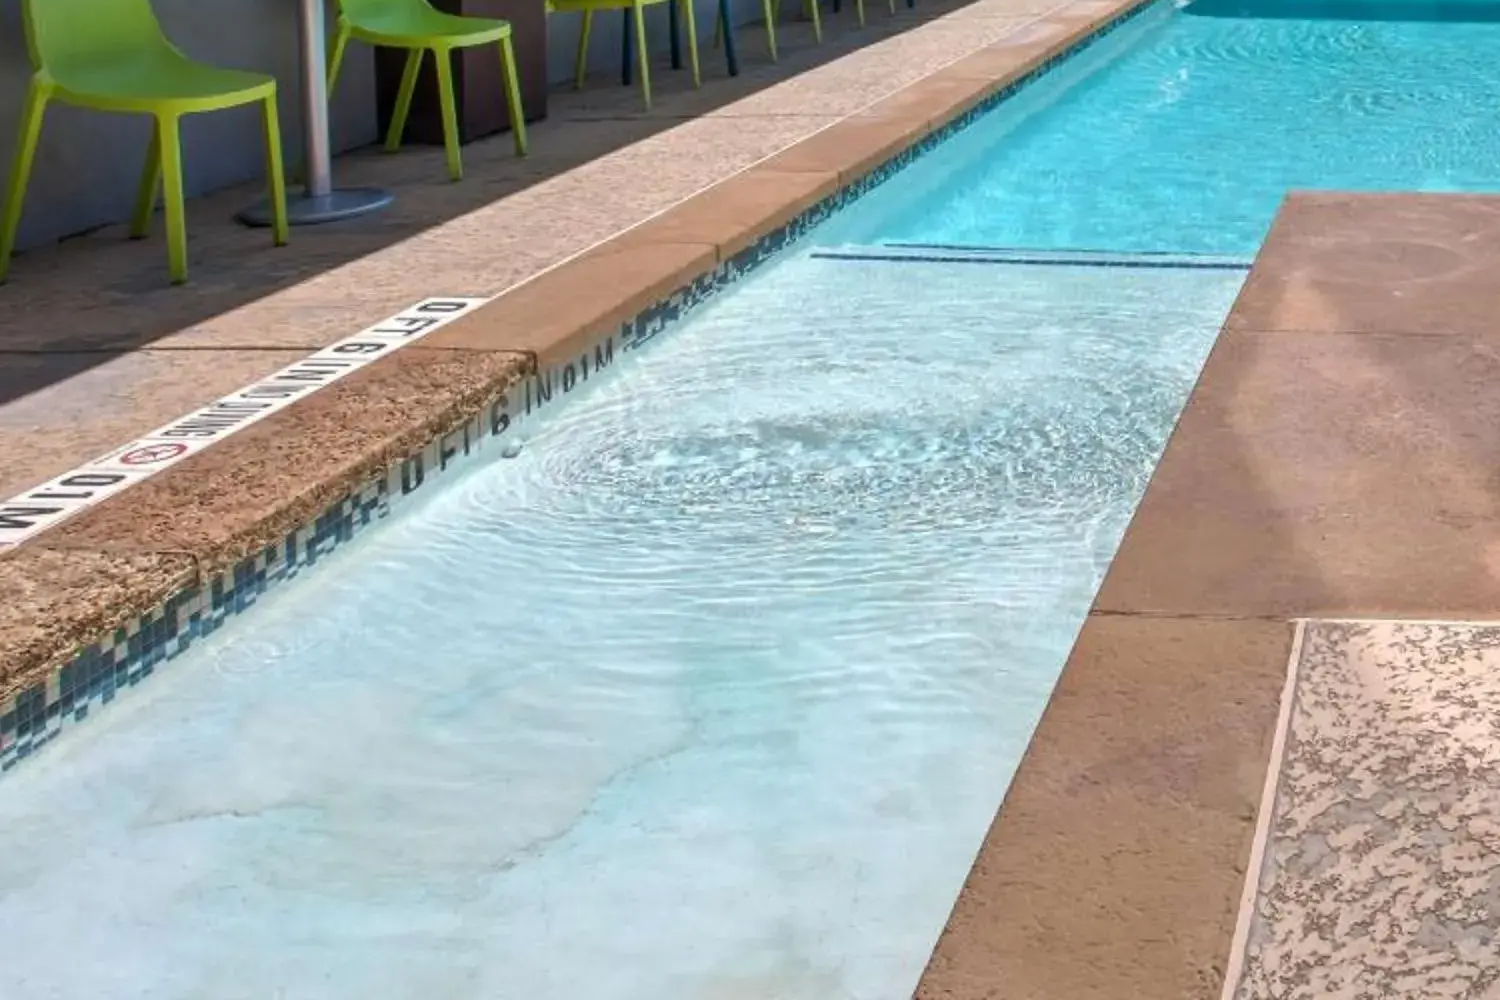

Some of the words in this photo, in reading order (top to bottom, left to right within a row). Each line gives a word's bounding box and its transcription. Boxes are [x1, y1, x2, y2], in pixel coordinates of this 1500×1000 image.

[370, 316, 440, 337] FT
[332, 342, 388, 354] 6
[274, 362, 352, 381] IN
[490, 394, 511, 436] 6
[0, 507, 65, 529] M
